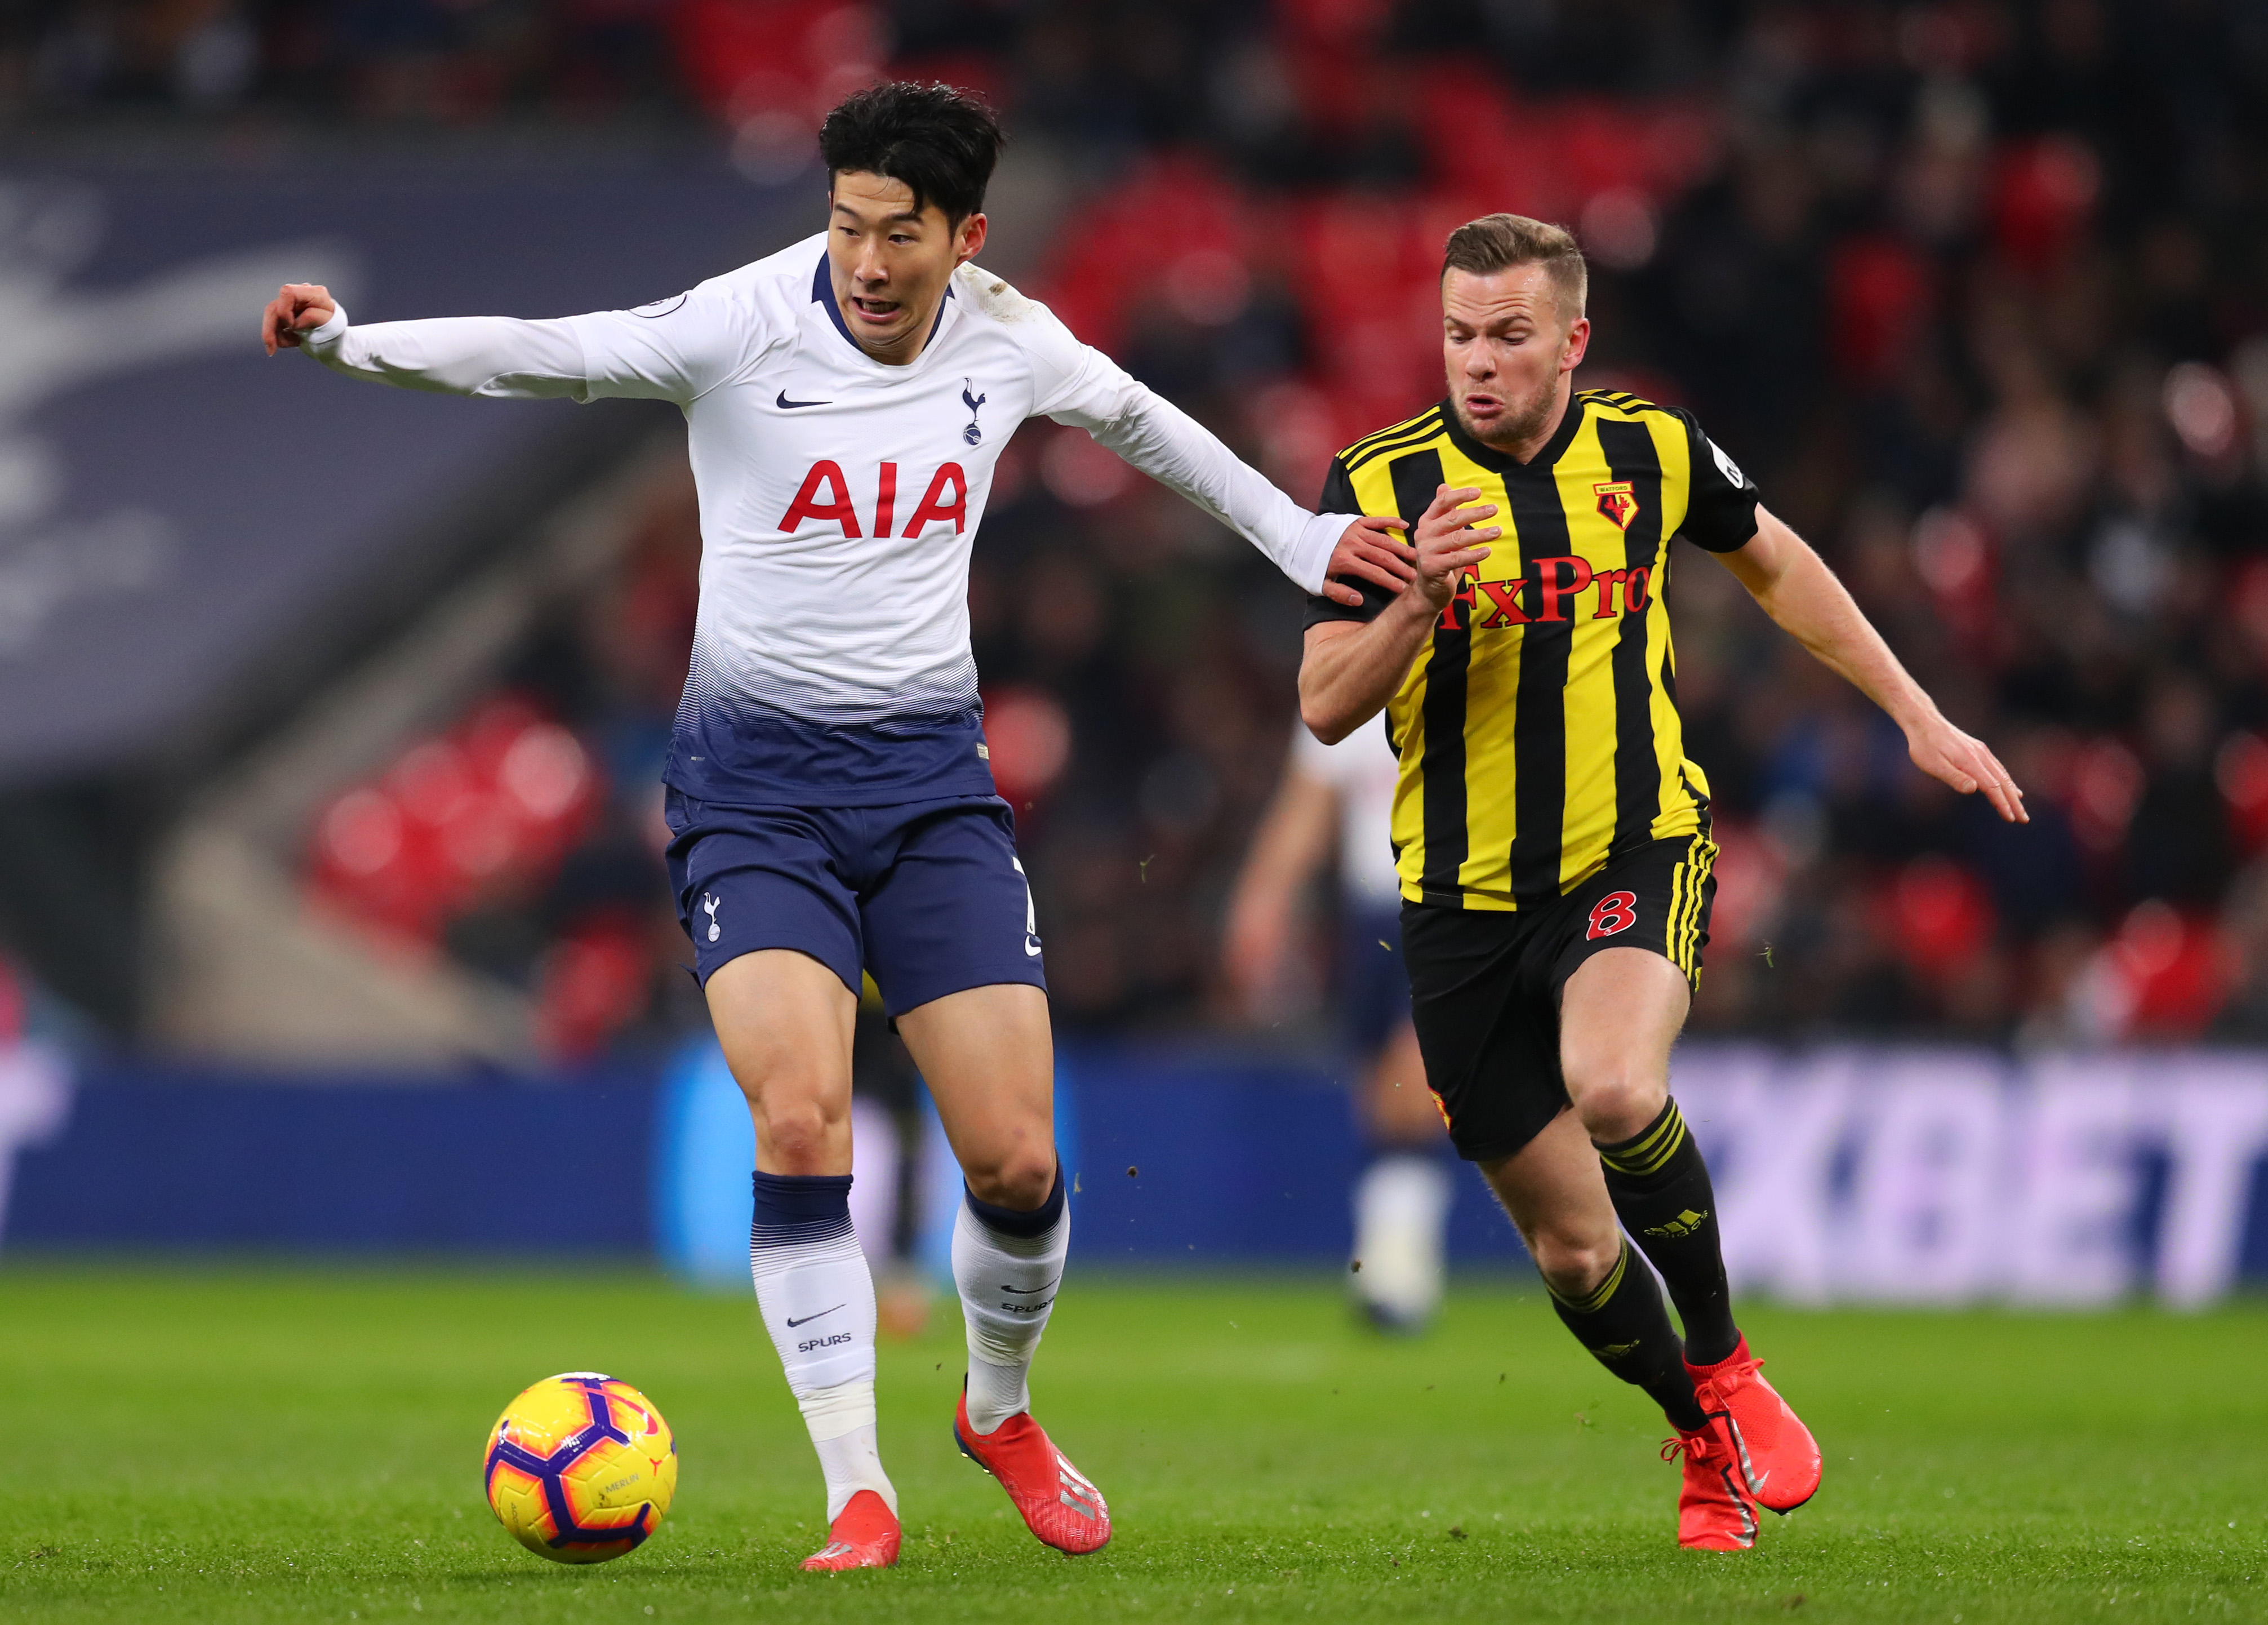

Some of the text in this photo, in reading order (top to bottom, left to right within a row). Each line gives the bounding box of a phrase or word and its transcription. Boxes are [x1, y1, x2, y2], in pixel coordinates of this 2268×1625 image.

[777, 459, 967, 539] AIA
[1439, 555, 1650, 630] FxPro
[1586, 890, 1637, 941] 8
[798, 1333, 851, 1353] SPURS
[605, 1472, 640, 1494] MERLIN
